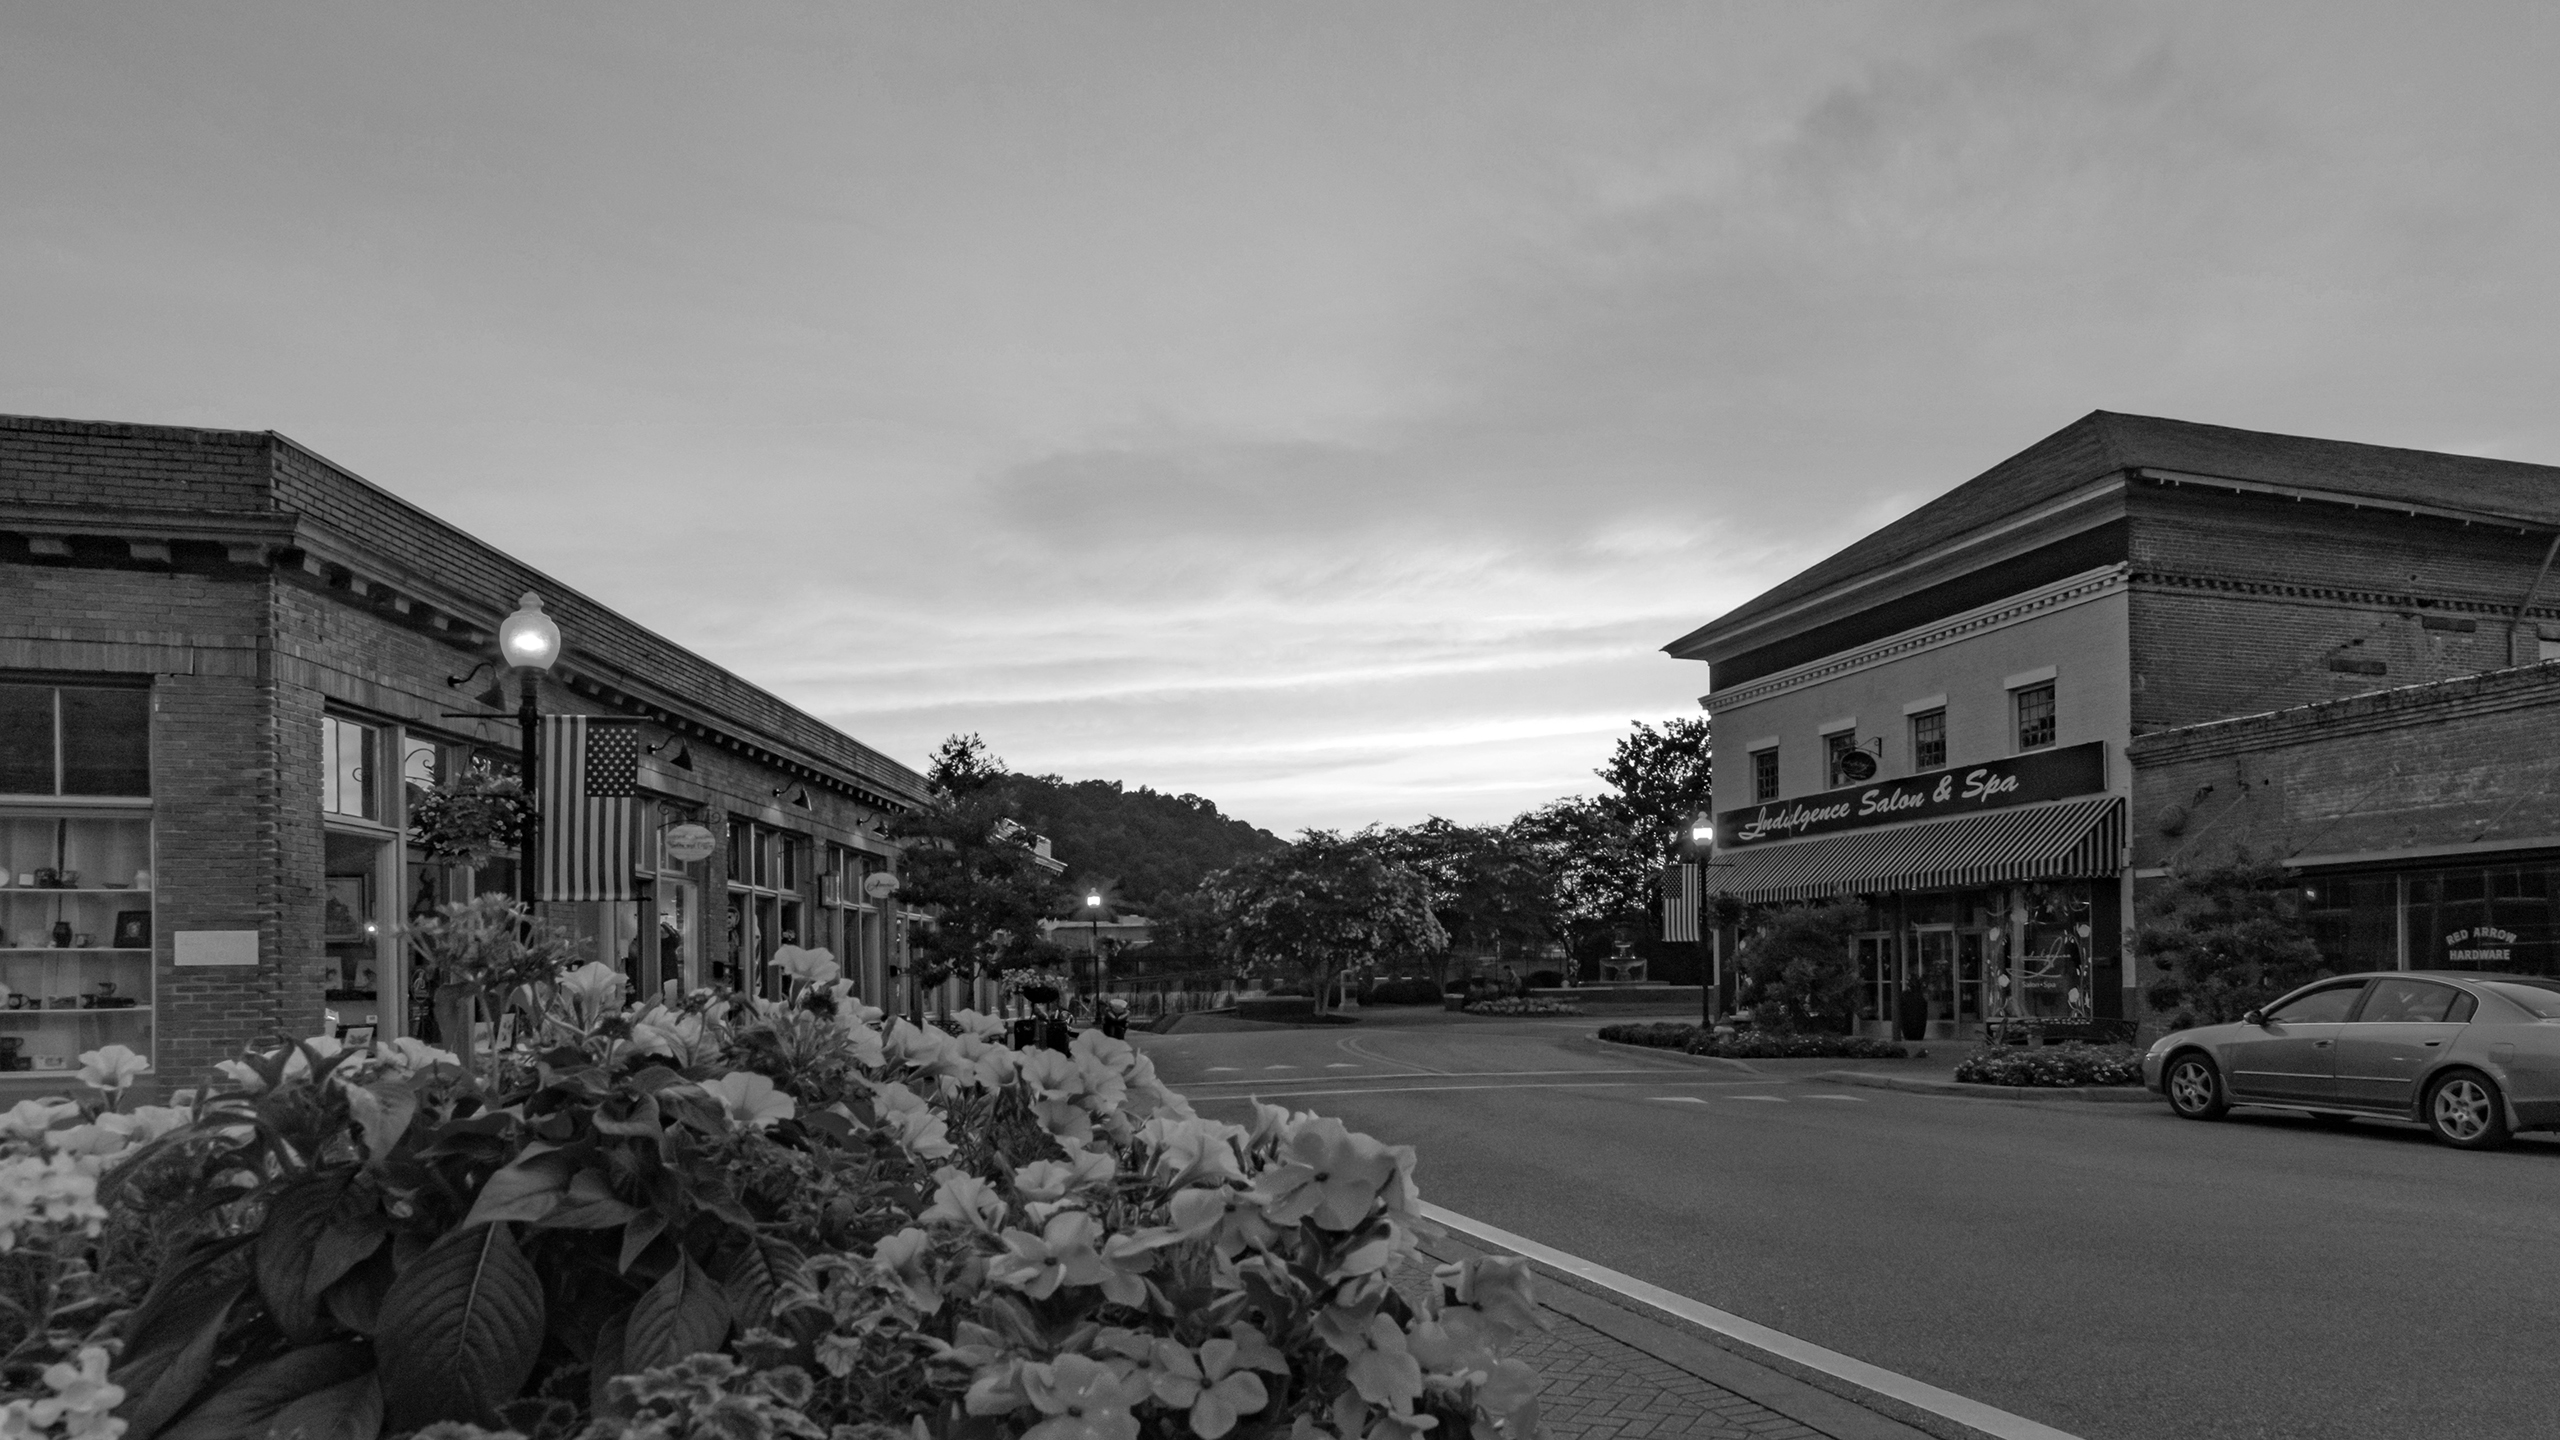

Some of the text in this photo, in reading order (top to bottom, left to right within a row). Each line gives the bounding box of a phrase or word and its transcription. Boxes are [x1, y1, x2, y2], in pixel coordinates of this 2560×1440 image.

[1739, 768, 2019, 840] Indulgence Salon & Spa
[2445, 926, 2517, 946] RED ARROW
[2449, 948, 2511, 961] HARDWARE
